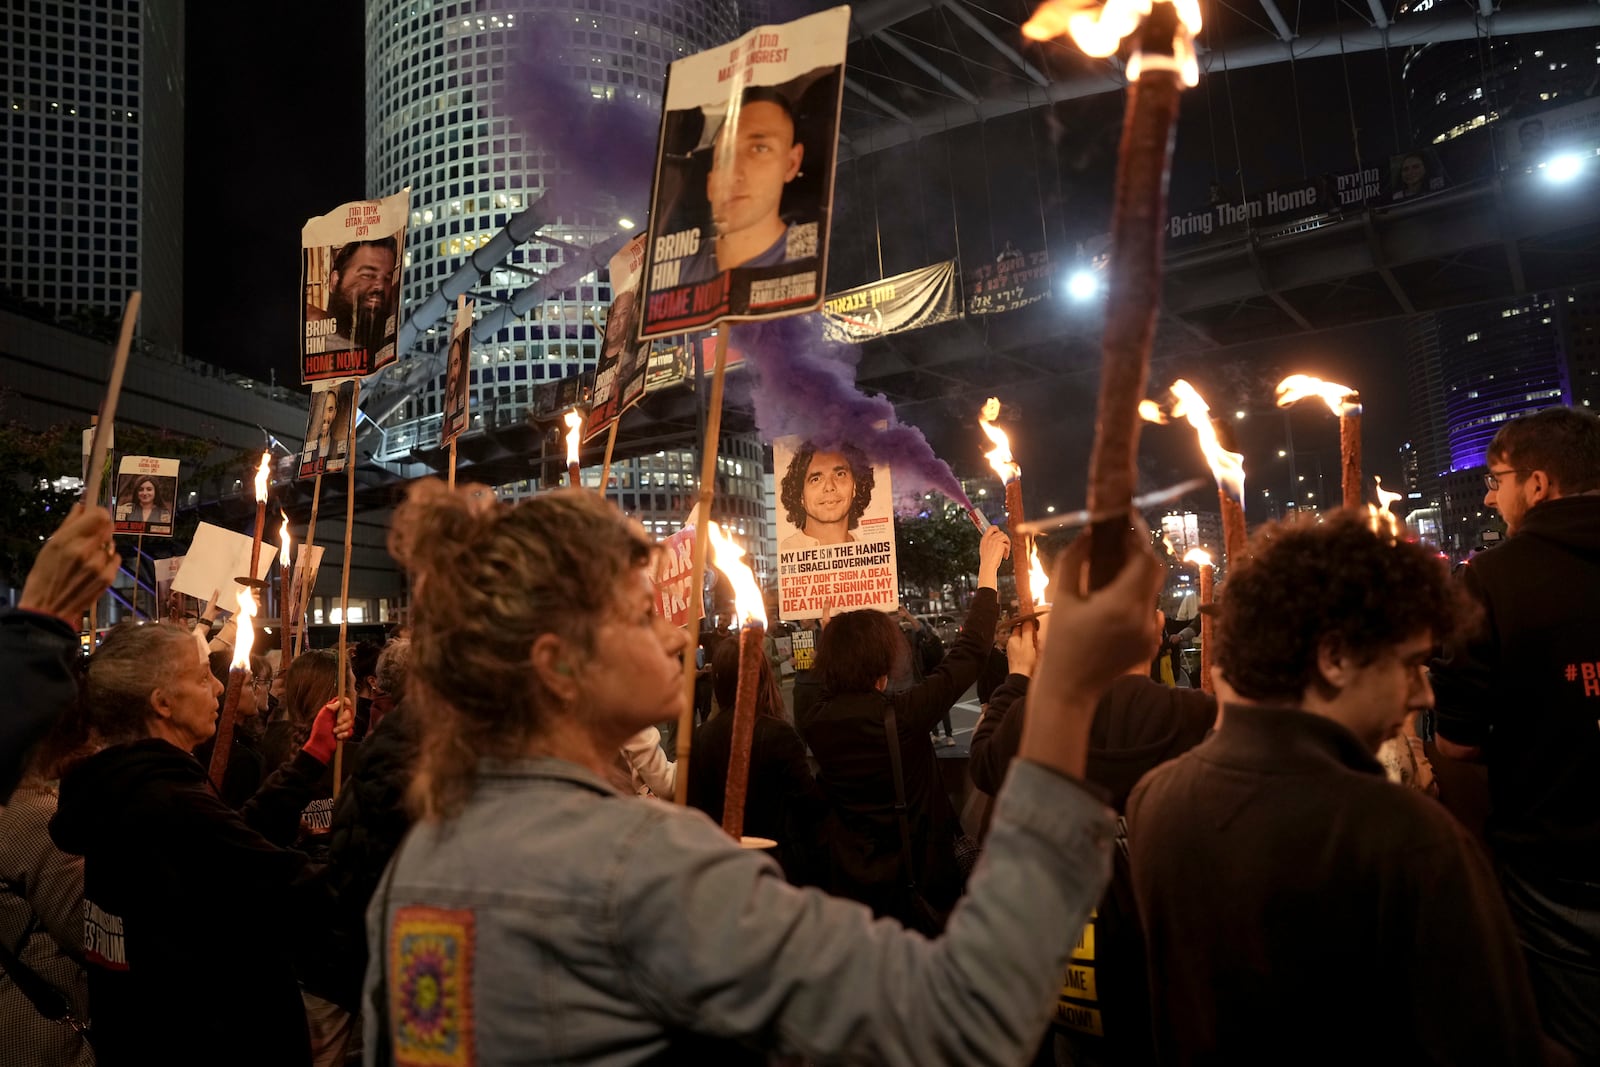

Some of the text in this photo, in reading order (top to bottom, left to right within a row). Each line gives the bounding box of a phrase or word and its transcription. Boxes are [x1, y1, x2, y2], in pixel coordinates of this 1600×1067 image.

[759, 34, 779, 48] מתן
[1170, 186, 1317, 237] Bring Them Home
[345, 217, 362, 228] EITAN
[356, 225, 369, 237] (37)
[654, 227, 700, 263] BRING
[651, 259, 681, 291] HIM
[647, 287, 691, 322] HOME
[306, 317, 337, 337] BRING
[306, 336, 326, 354] HIM
[306, 354, 334, 373] HOME
[336, 348, 367, 369] NOW!
[781, 541, 890, 564] MY LIFE IS IN THE HANDS
[781, 554, 891, 575] OF THE ISRAELI GOVERNMENT
[781, 567, 892, 587] IF THEY DON'T SIGN A DEAL
[782, 578, 892, 599] THEY ARE SIGNING MY
[783, 590, 893, 612] DEATH WARRANT!
[301, 810, 333, 829] FORU
